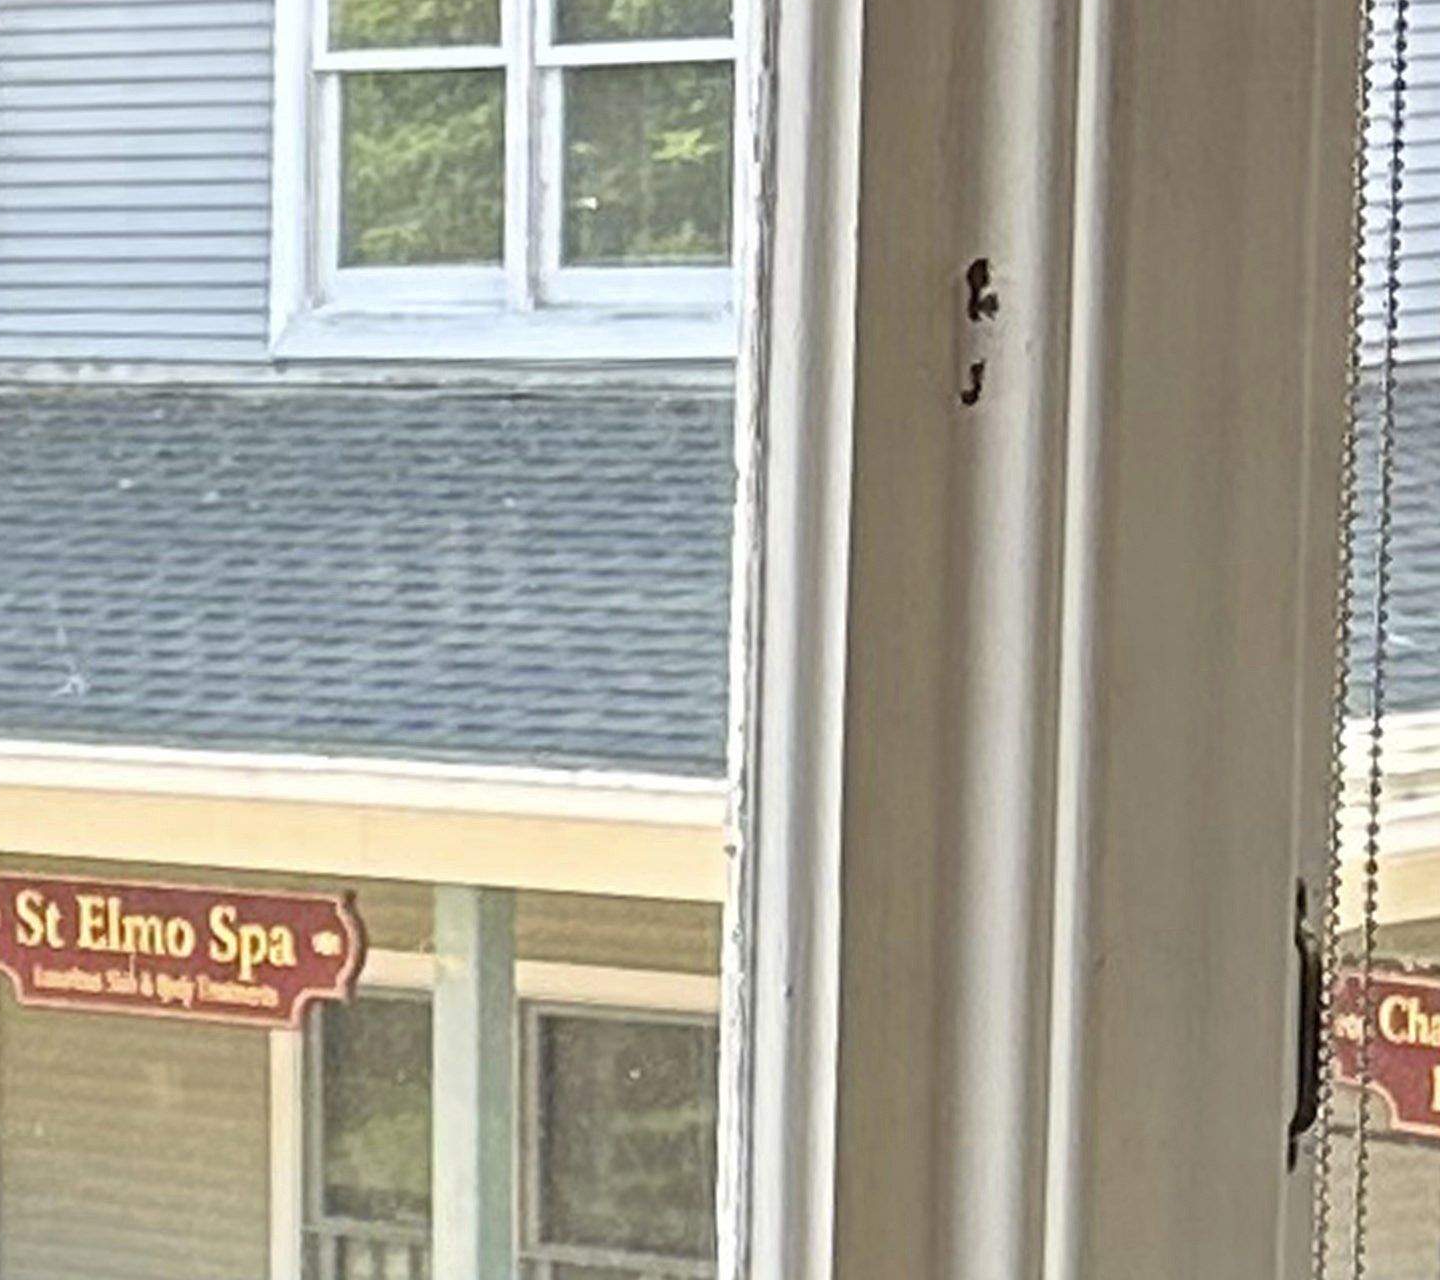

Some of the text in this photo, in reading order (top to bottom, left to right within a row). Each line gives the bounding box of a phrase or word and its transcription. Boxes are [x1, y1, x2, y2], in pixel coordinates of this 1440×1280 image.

[15, 889, 298, 982] St Elmo Spa
